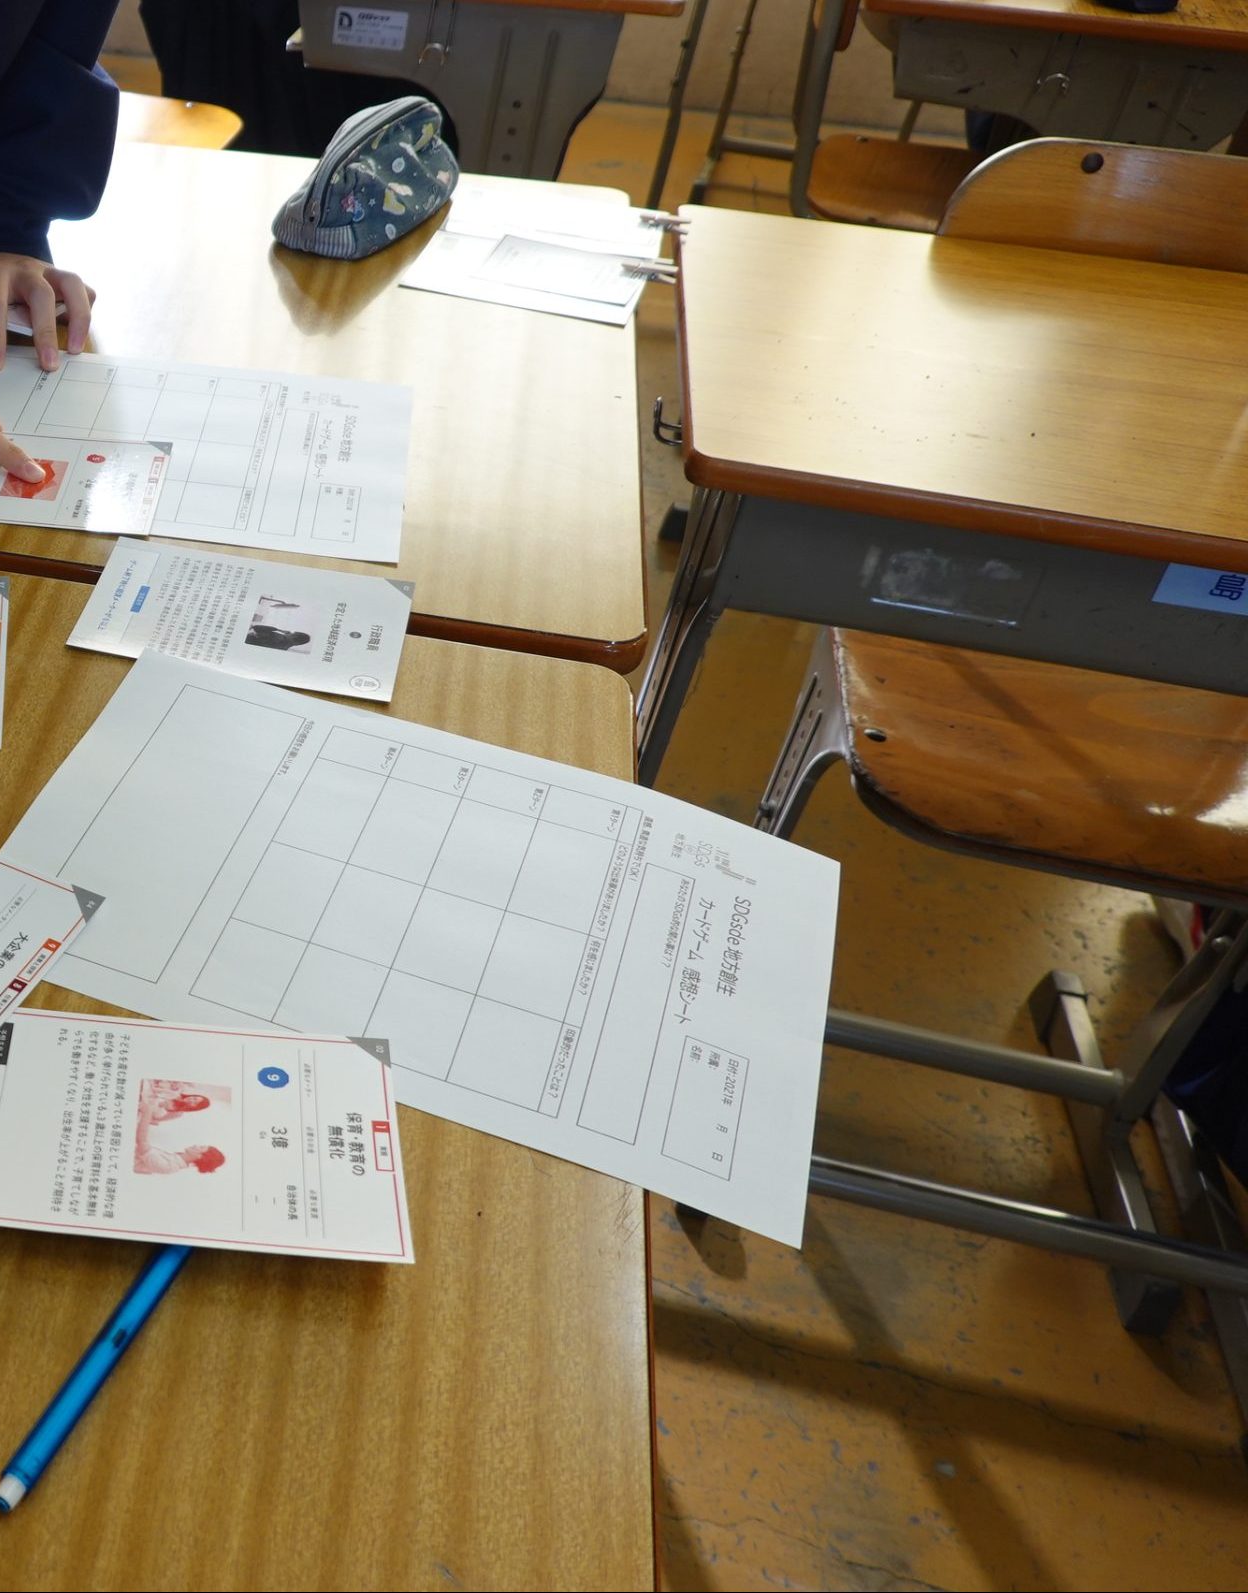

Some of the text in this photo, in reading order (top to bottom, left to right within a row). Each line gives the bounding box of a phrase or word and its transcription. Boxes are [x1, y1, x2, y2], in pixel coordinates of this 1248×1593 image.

[672, 896, 715, 1027] カードゲーム 感想シート
[715, 894, 752, 998] SDGsde 地方創生
[56, 1027, 68, 1047] れる。
[266, 1072, 279, 1081] 9
[546, 1027, 575, 1099] 印象的だったことは？
[270, 1125, 288, 1149] 3億
[326, 1124, 345, 1160] 無償化
[345, 1111, 367, 1176] 保育・教育の
[715, 1122, 728, 1133] 月
[710, 1151, 723, 1162] 日
[285, 1183, 298, 1221] 自治体の長
